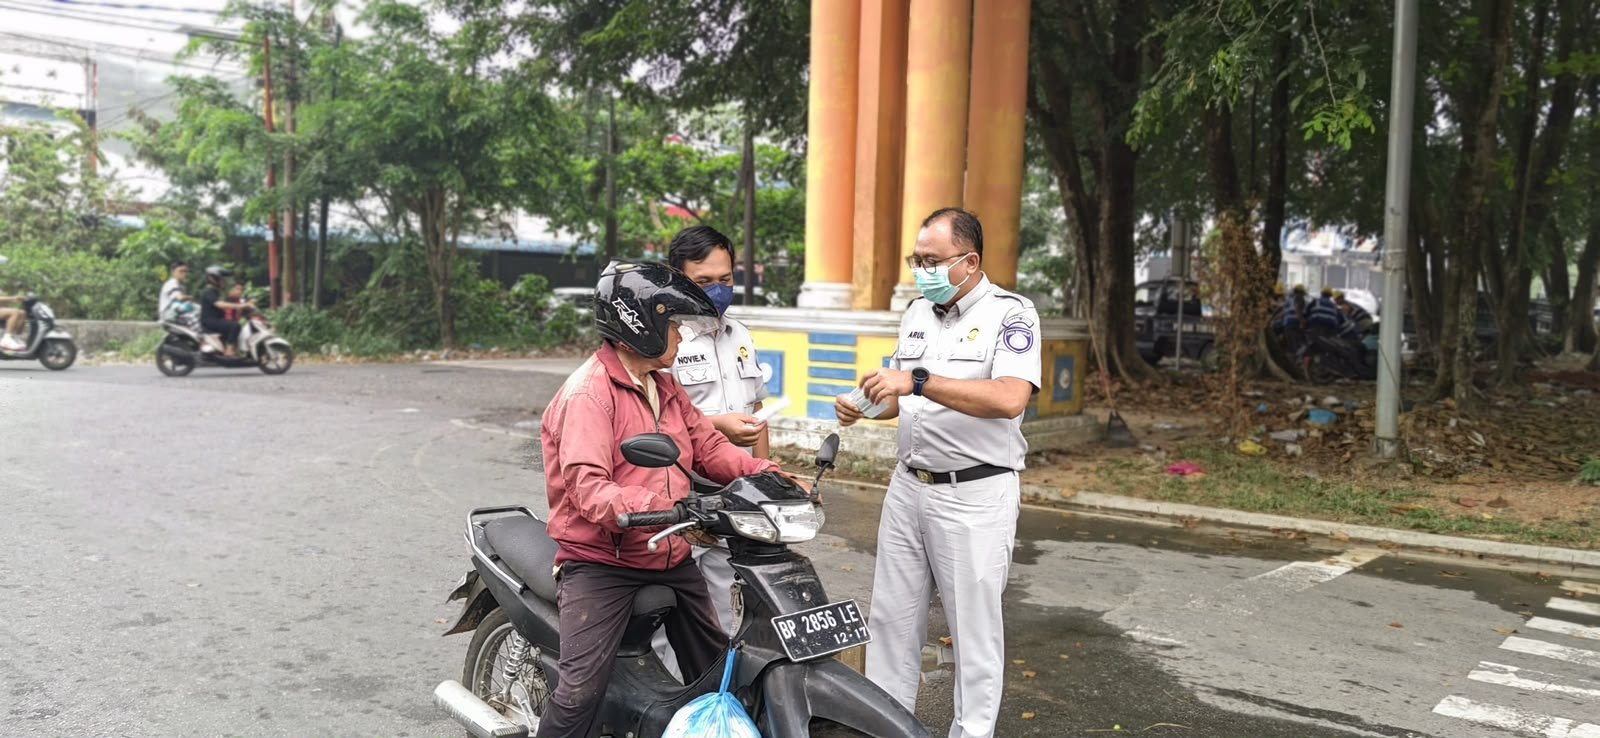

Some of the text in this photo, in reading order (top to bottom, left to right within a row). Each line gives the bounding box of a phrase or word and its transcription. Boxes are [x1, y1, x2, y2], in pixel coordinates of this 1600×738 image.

[907, 331, 925, 340] ARUL
[778, 604, 859, 639] BP 2856 LE
